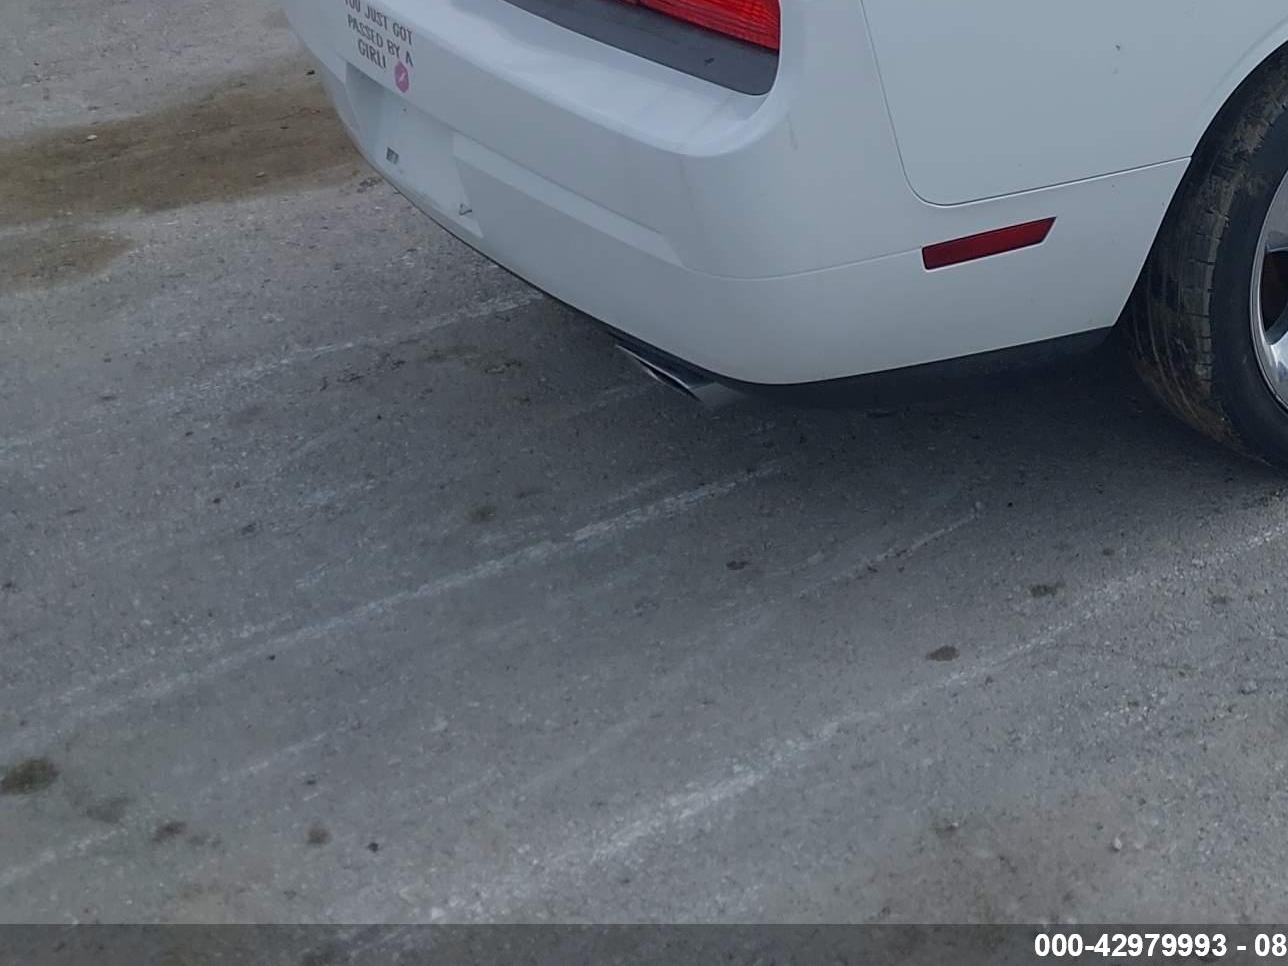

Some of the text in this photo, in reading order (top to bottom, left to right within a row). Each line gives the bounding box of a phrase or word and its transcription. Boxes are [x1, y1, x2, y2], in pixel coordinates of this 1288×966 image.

[347, 13, 414, 68] PASSED BY A
[365, 4, 388, 31] JUST
[392, 22, 413, 46] GOT
